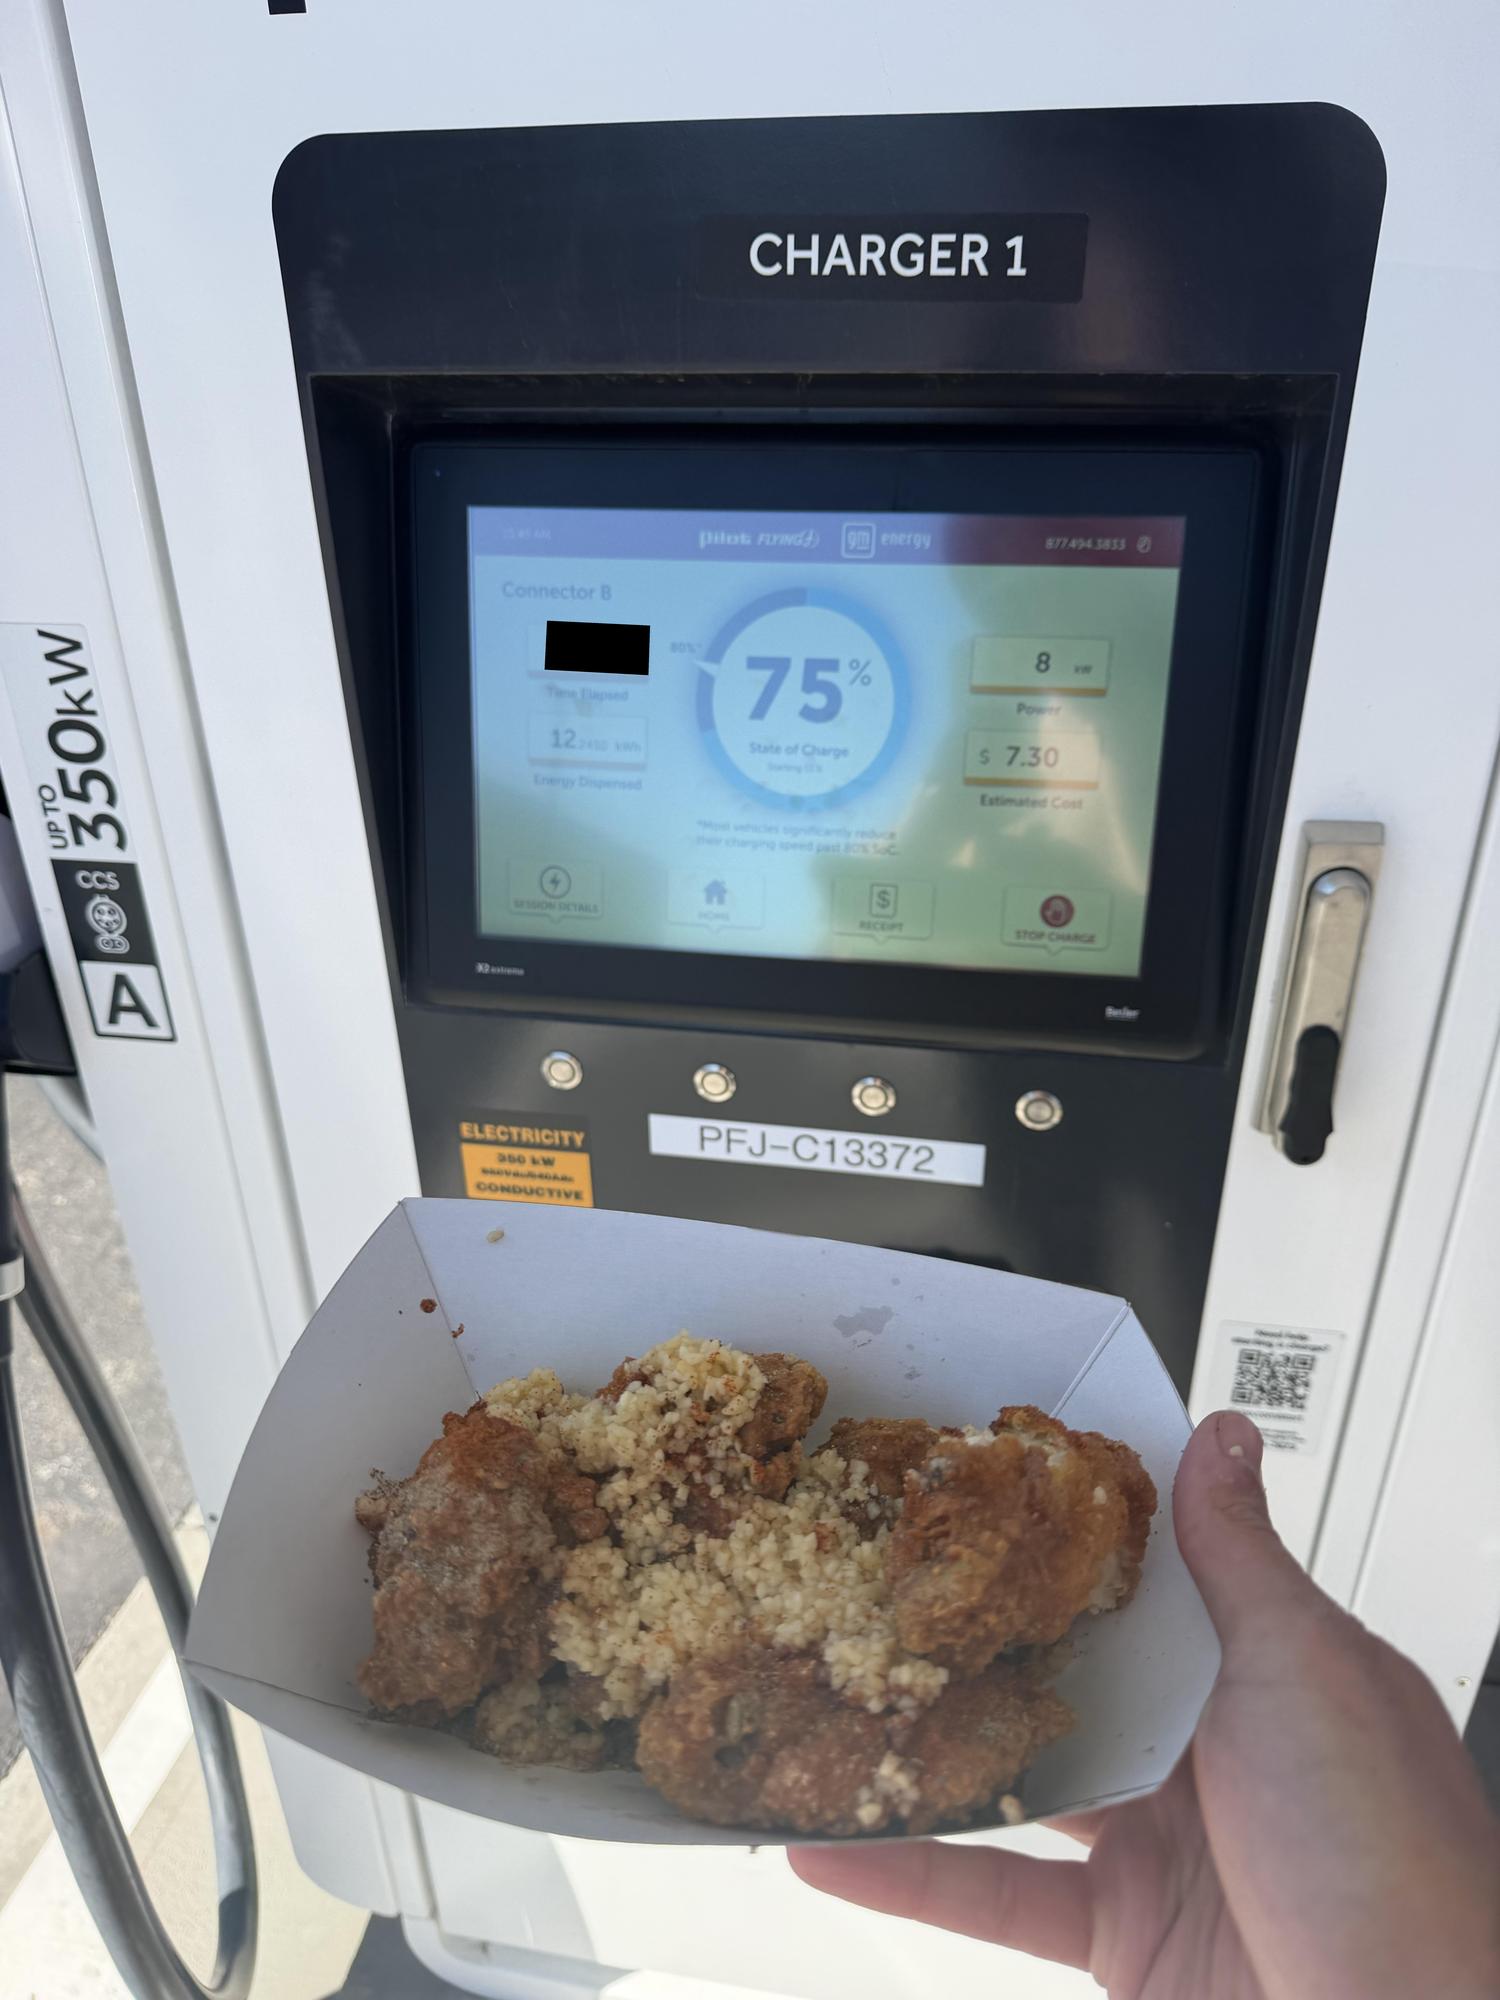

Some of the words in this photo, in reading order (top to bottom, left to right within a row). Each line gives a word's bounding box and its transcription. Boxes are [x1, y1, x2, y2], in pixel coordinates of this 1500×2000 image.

[749, 232, 990, 277] CHARGER
[1005, 235, 1028, 277] 1
[699, 530, 751, 549] pilot
[757, 531, 801, 547] FLYING
[881, 532, 932, 549] energy
[502, 581, 596, 601] Connector
[600, 584, 613, 601] B
[1035, 651, 1052, 674] 8
[546, 684, 577, 699] Time
[580, 687, 629, 704] Elapsed
[1016, 701, 1062, 717] Power
[37, 628, 128, 852] 350kW
[749, 742, 781, 755] State
[784, 742, 799, 755] of
[802, 744, 849, 760] Charge
[979, 747, 991, 766] $
[1005, 745, 1060, 768] 7.30
[533, 773, 576, 790] Energy
[578, 775, 642, 792] Dispensed
[38, 783, 58, 816] TO
[980, 793, 1049, 810] Estimated
[1051, 795, 1083, 810] Cost
[48, 821, 69, 850] UP
[733, 821, 780, 833] vehicles
[782, 823, 852, 839] significantly
[855, 828, 897, 840] reduce
[696, 835, 723, 847] their
[725, 836, 777, 852] charging
[779, 839, 814, 855] speed
[815, 842, 842, 856] past
[75, 869, 121, 892] CCS
[513, 898, 555, 911] SESSION
[558, 901, 599, 914] DETAILS
[697, 910, 730, 922] HOME
[859, 920, 904, 933] RECEIPT
[1015, 929, 1045, 941] STOP
[1047, 931, 1096, 944] CHARGE
[108, 973, 160, 1030] A
[459, 1121, 586, 1148] ELECTRICITY
[699, 1125, 935, 1174] PFJ-C13372
[530, 1154, 556, 1167] kW
[475, 1181, 584, 1200] CONDUCTIVE
